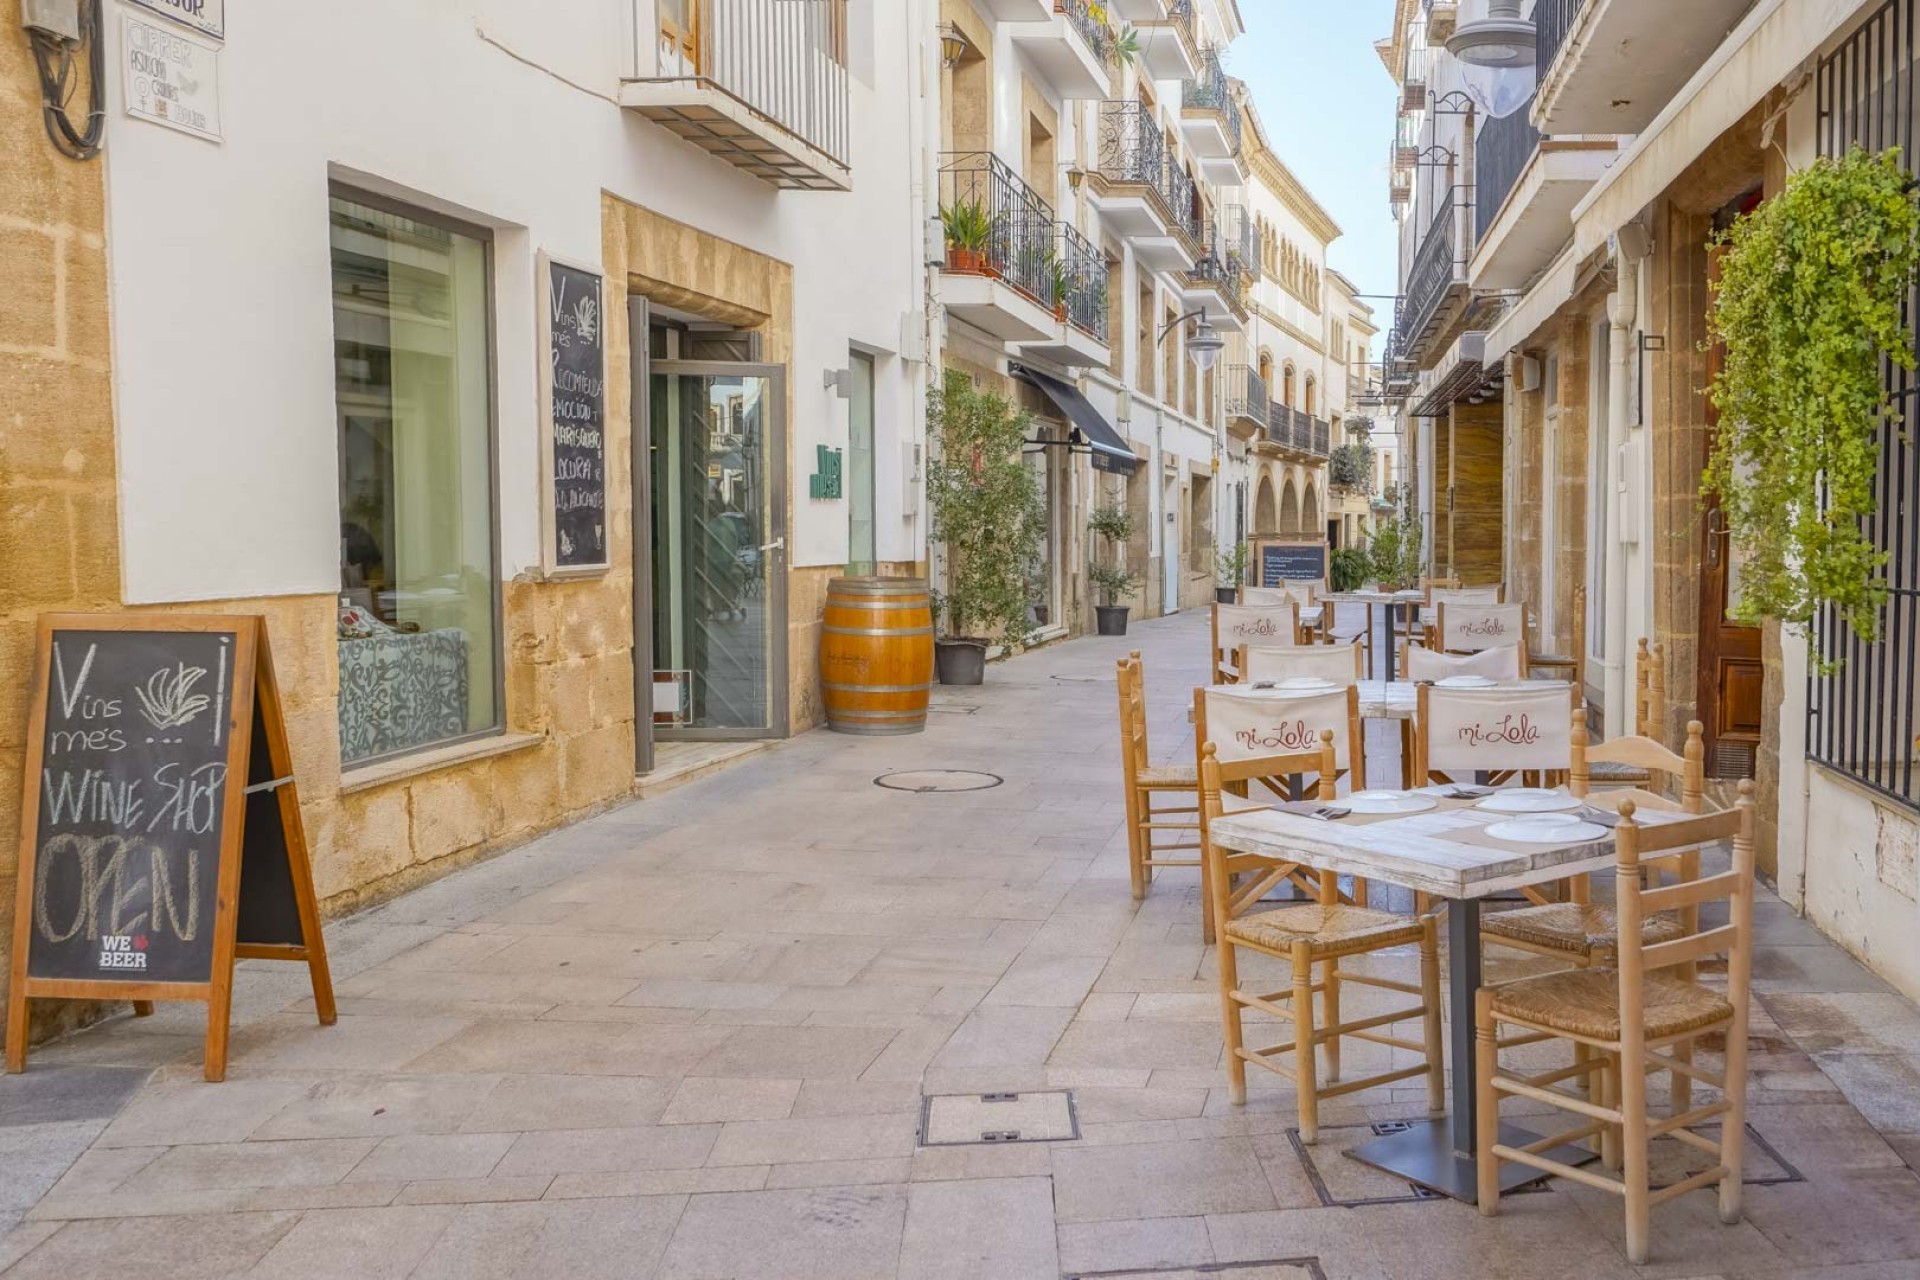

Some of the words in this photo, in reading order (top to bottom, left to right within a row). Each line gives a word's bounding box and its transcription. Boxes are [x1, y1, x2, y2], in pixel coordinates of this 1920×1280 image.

[1247, 618, 1277, 636] Lola
[1475, 618, 1506, 636] Lola
[54, 641, 122, 719] Vins
[1235, 728, 1261, 750] mi
[1262, 719, 1318, 750] Lola
[1458, 723, 1485, 747] mi
[1485, 713, 1543, 745] Lola
[147, 761, 228, 835] SHOP
[35, 832, 201, 943] OPEN
[102, 935, 132, 951] WE
[100, 951, 147, 968] BEER
